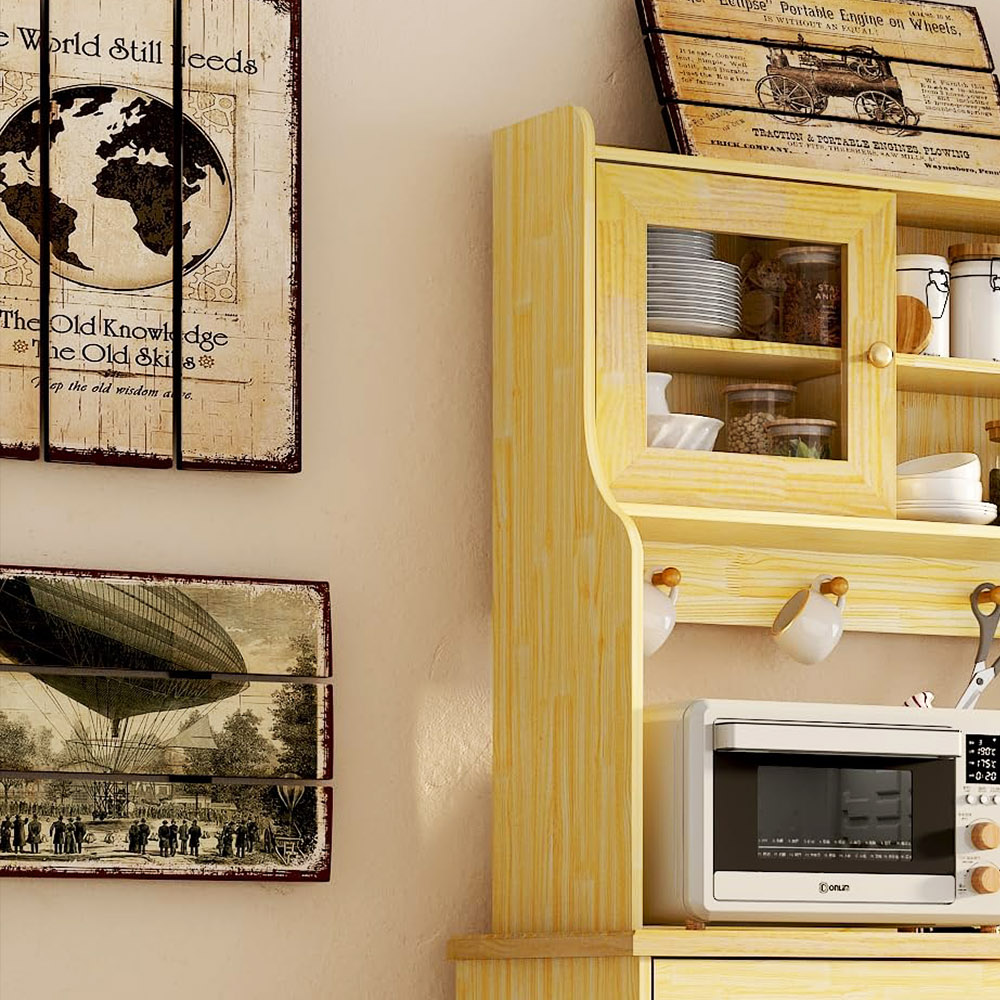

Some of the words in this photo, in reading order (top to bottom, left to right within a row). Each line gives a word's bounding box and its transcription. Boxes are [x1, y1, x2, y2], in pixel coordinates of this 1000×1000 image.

[763, 14, 774, 23] IS
[775, 16, 823, 29] WITHOUT
[826, 21, 838, 31] AN
[780, 0, 835, 21] Portable
[839, 8, 885, 28] Engine
[889, 17, 906, 30] on
[908, 17, 962, 37] Wheels,
[17, 26, 101, 58] World
[108, 36, 164, 65] Still
[710, 139, 741, 149] FRICK
[751, 127, 804, 142] TRACTION
[806, 133, 815, 142] &
[816, 134, 870, 149] PORTABLE
[872, 140, 922, 155] ENGINES,
[922, 146, 971, 160] PLOWING
[923, 162, 978, 175] Waynesboro,
[0, 308, 40, 332] The
[50, 314, 97, 336] Old
[81, 343, 129, 365] Old
[135, 346, 196, 370] Skis
[68, 381, 88, 392] the
[91, 382, 113, 394] old
[116, 385, 159, 397] wisdom
